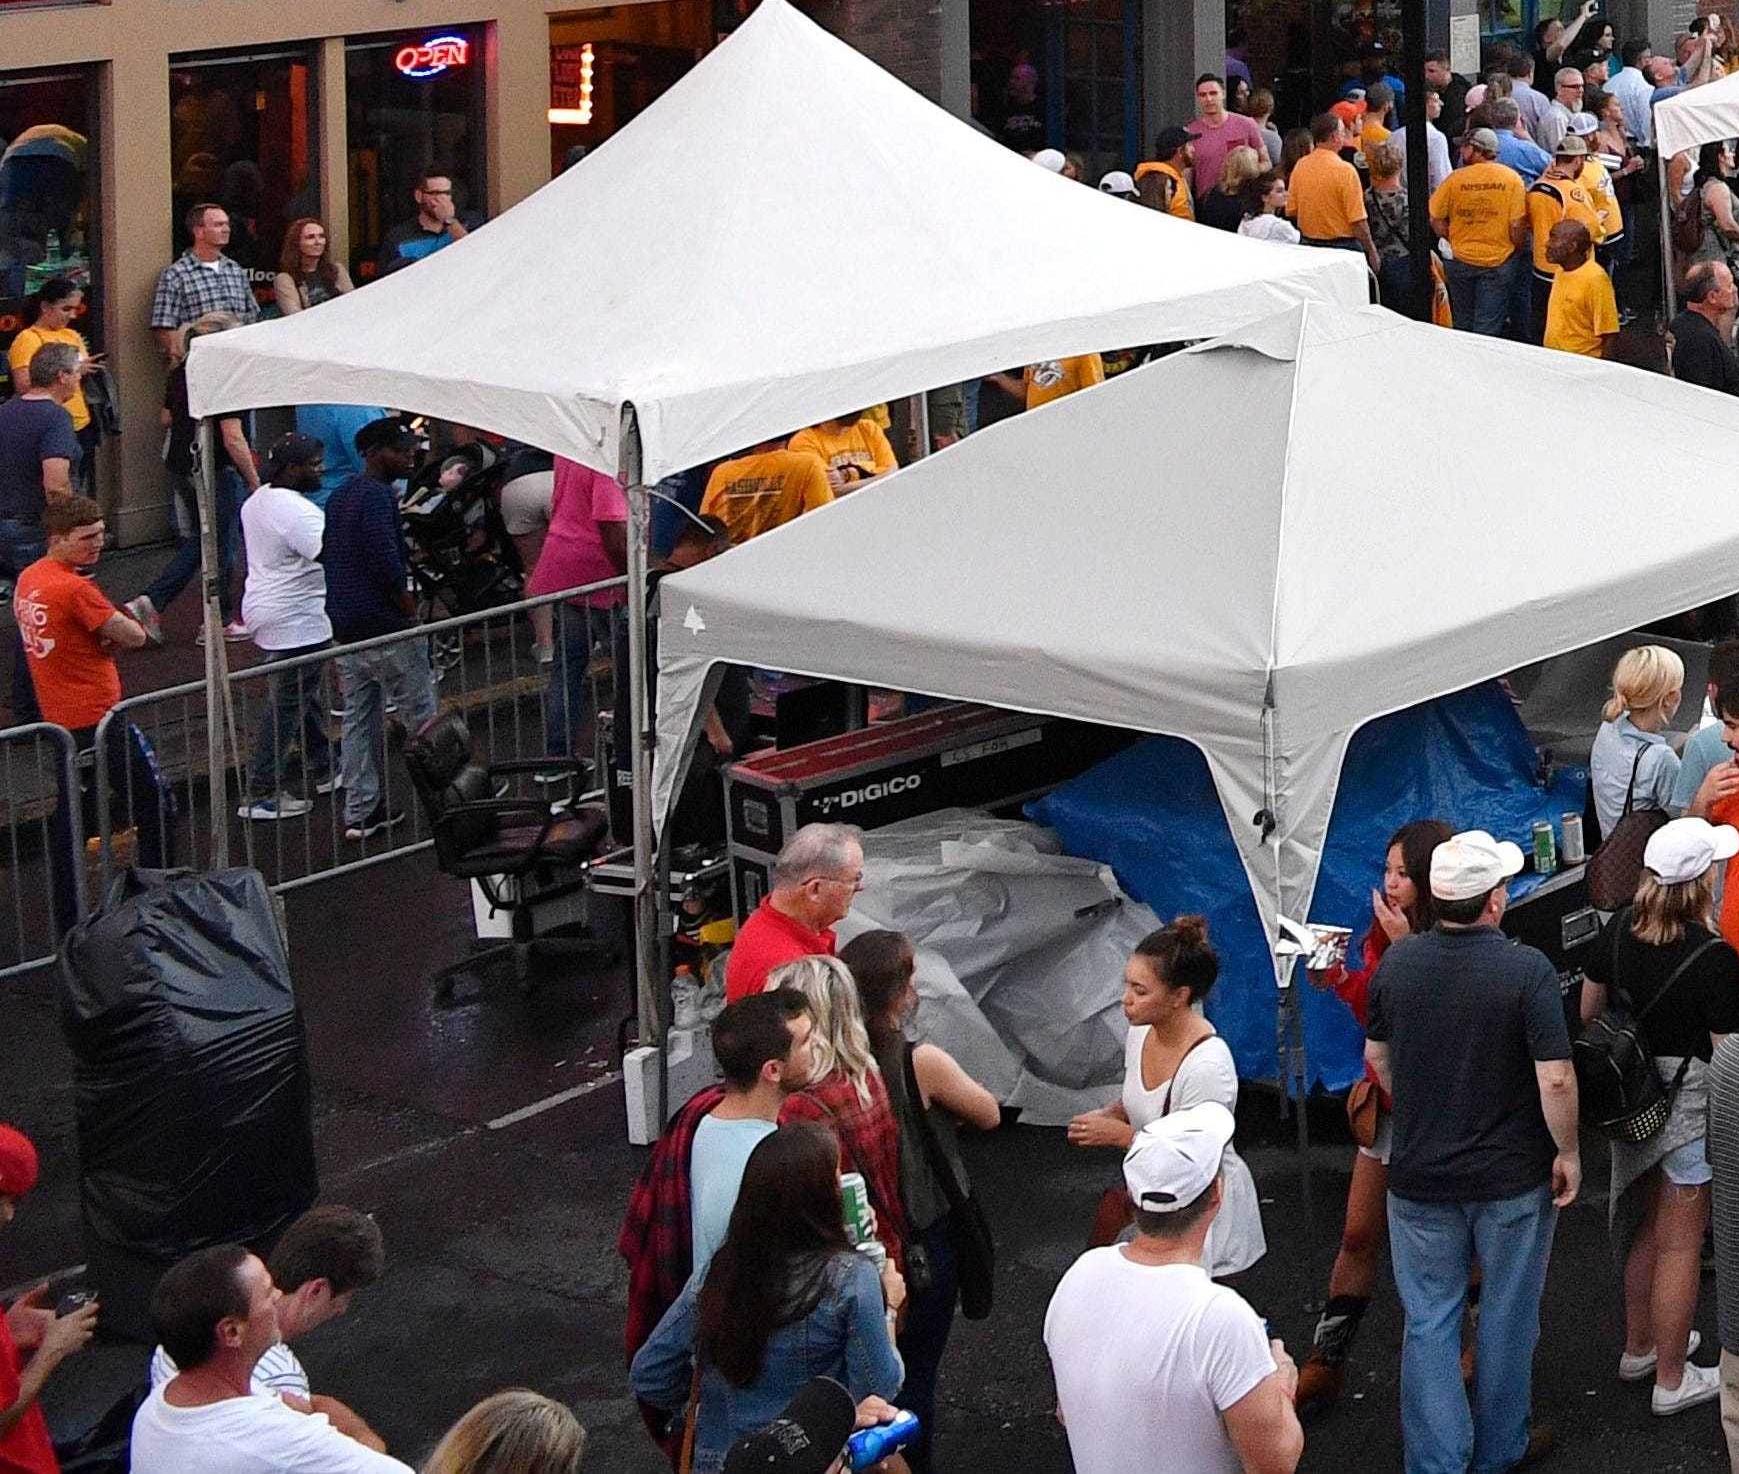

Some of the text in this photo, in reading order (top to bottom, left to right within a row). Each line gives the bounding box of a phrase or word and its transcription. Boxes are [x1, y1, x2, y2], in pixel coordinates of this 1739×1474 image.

[396, 44, 469, 71] OPEN
[1459, 183, 1507, 192] NISSAN
[840, 773, 921, 809] DiGiCo
